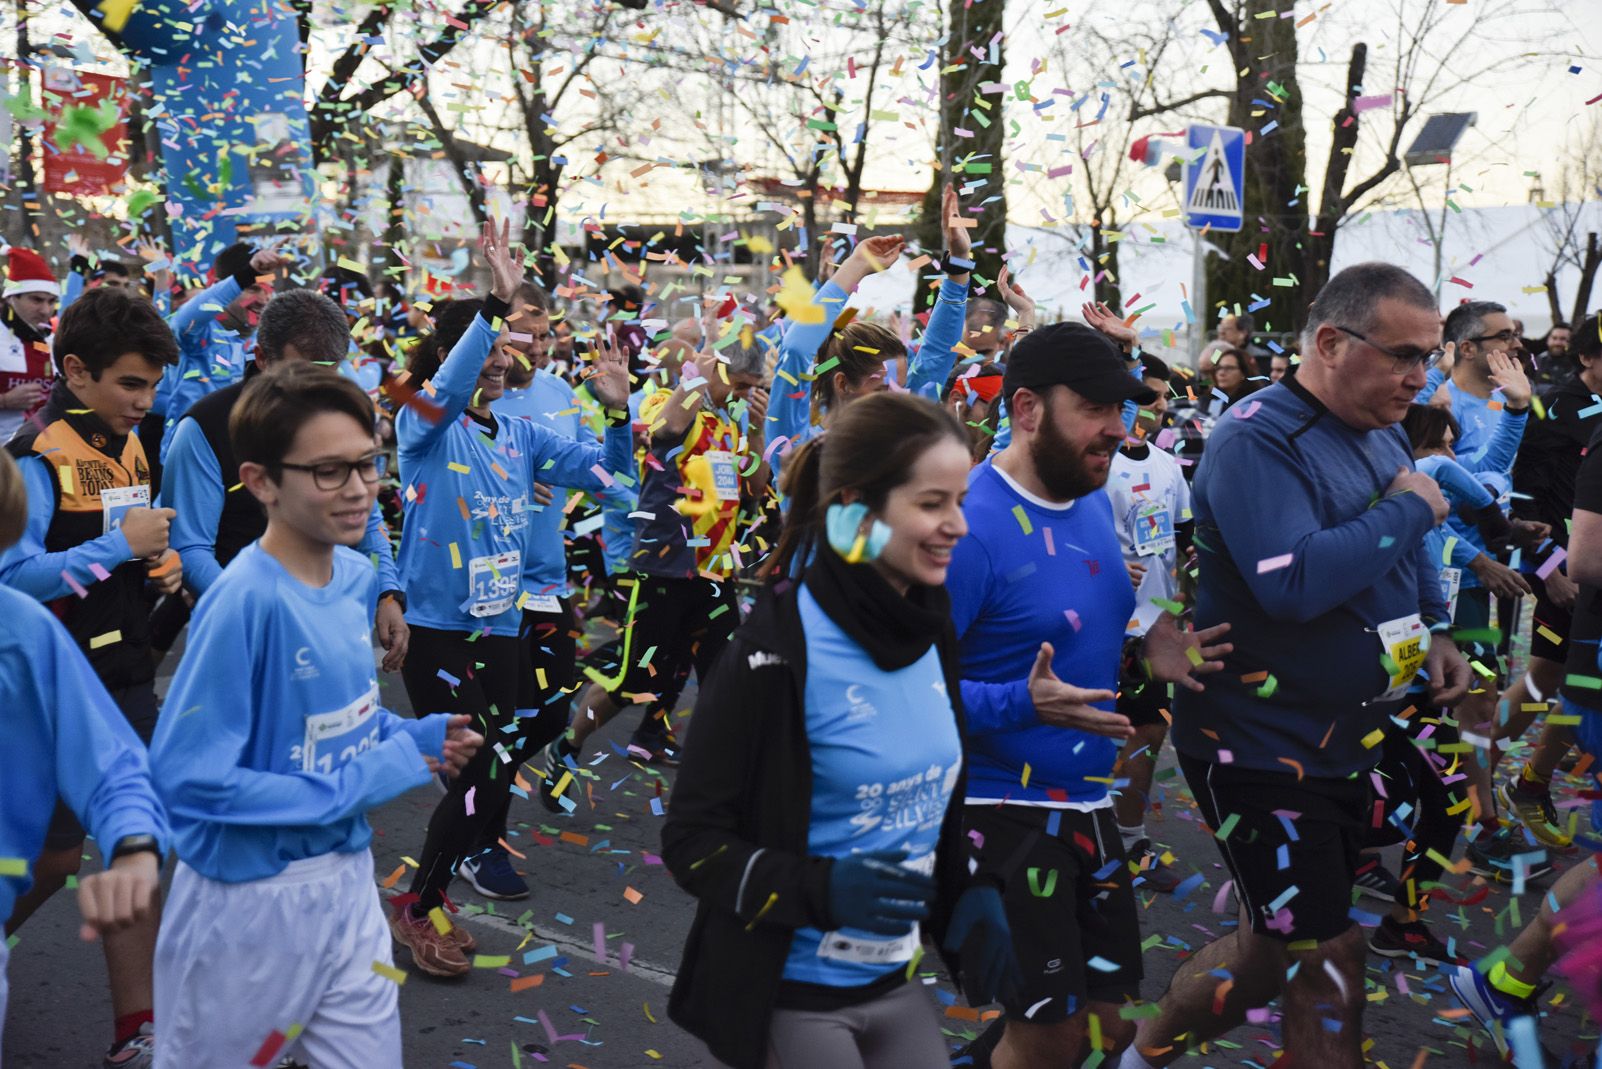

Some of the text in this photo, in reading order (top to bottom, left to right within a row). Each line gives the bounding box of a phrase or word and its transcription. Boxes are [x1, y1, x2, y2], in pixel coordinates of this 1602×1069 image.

[77, 467, 114, 481] BEGINS
[475, 573, 518, 600] 1395
[855, 782, 883, 800] 20
